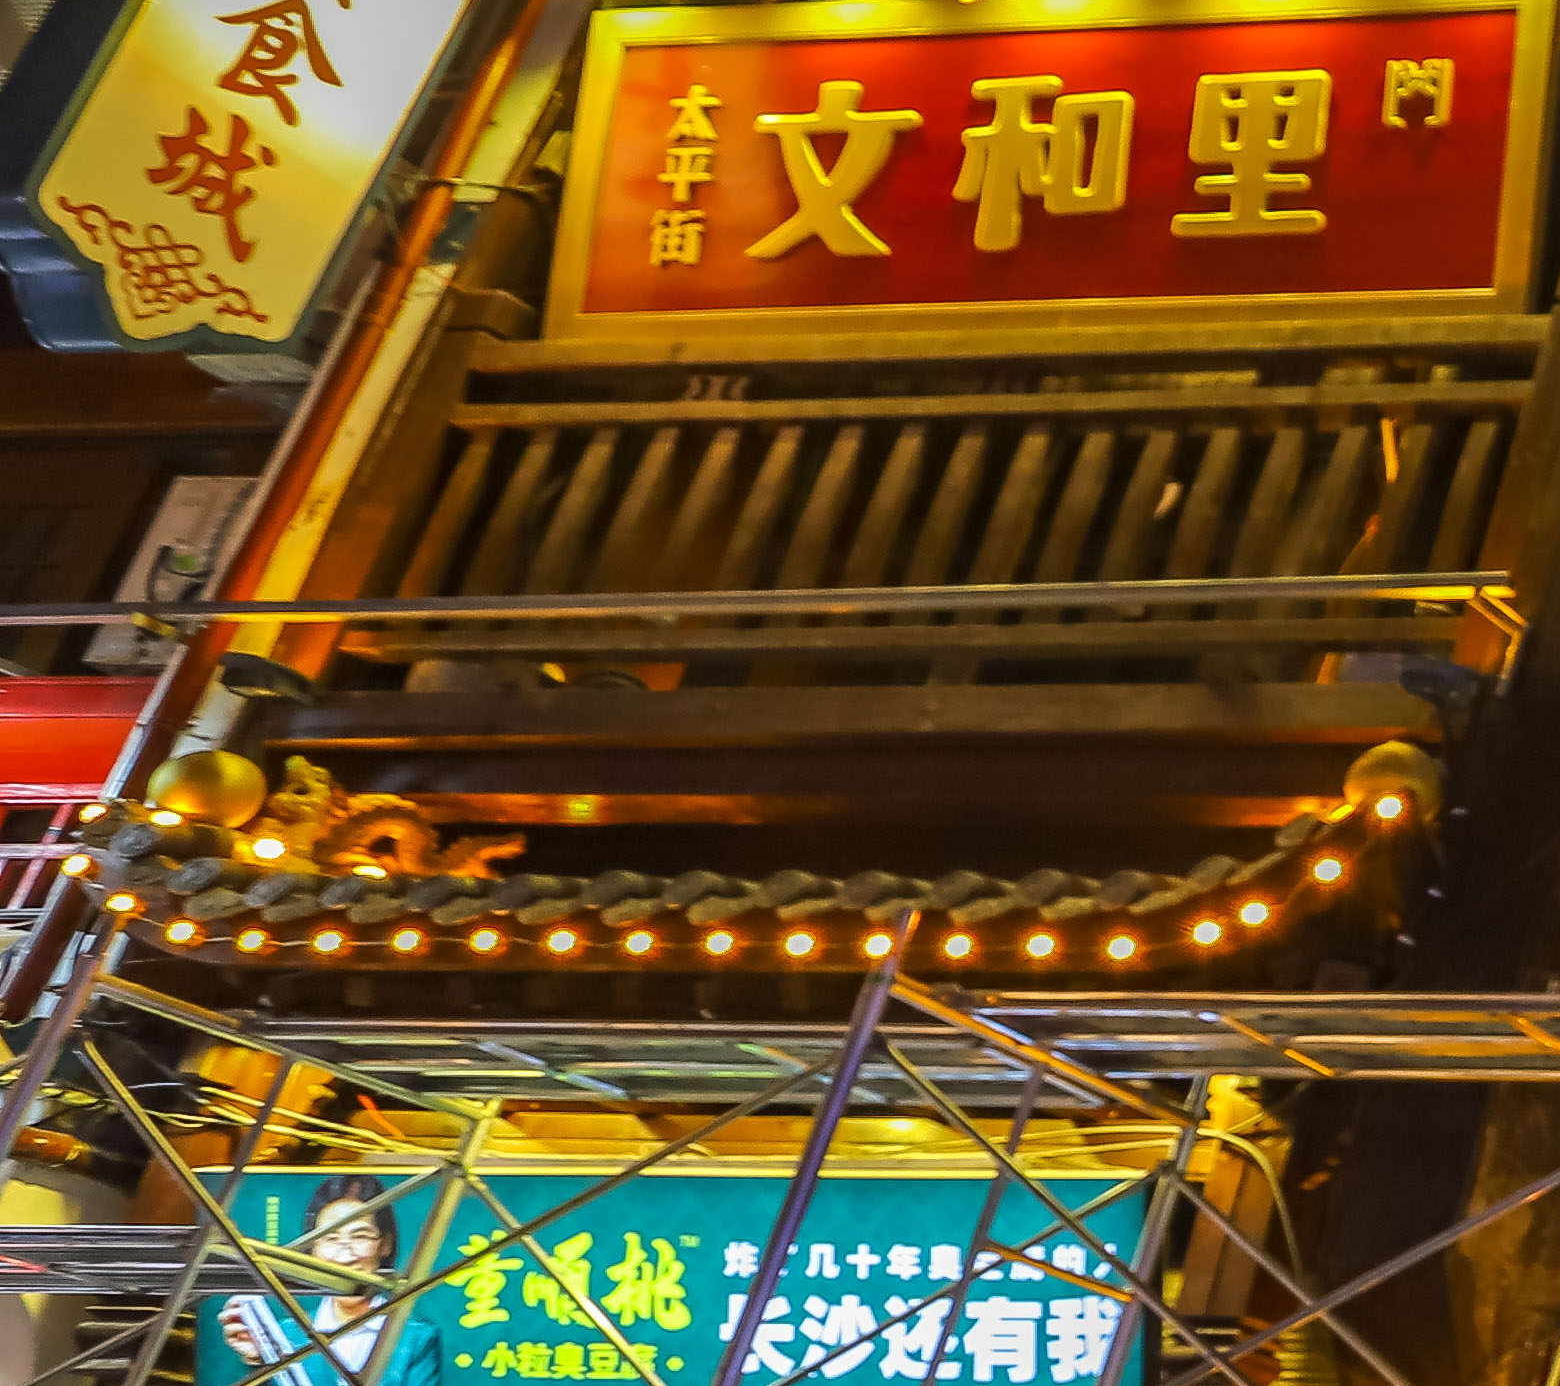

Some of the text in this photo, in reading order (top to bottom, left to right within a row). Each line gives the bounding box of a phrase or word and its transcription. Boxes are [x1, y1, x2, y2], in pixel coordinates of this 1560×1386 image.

[647, 82, 724, 268] 太平街
[743, 67, 1334, 260] 文和里
[719, 1293, 1124, 1384] 长沙还有我
